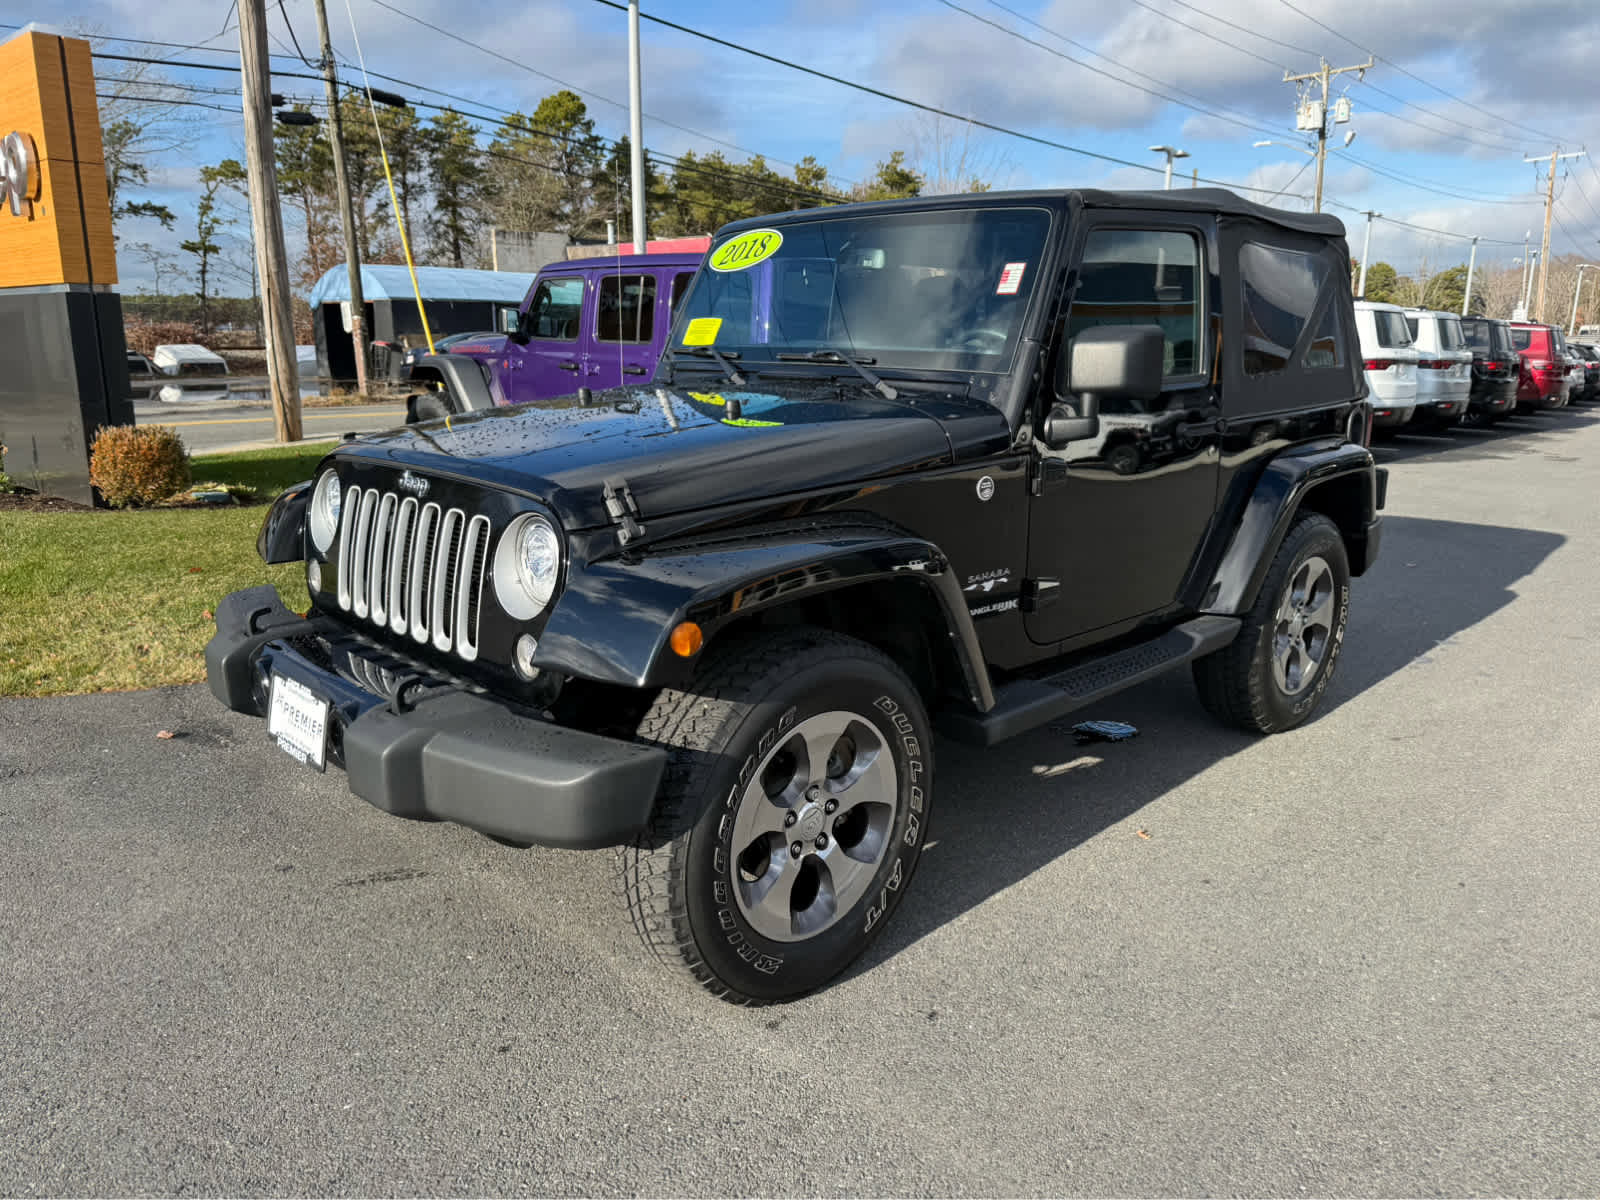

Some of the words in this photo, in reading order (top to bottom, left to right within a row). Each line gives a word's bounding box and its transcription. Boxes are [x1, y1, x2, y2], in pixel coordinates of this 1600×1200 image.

[718, 234, 772, 266] 2018
[967, 567, 1011, 584] SAHARA
[283, 701, 323, 735] PREMIER
[872, 695, 924, 847] DUELER
[713, 704, 798, 975] BRIDGESTONE
[864, 857, 903, 934] A/T
